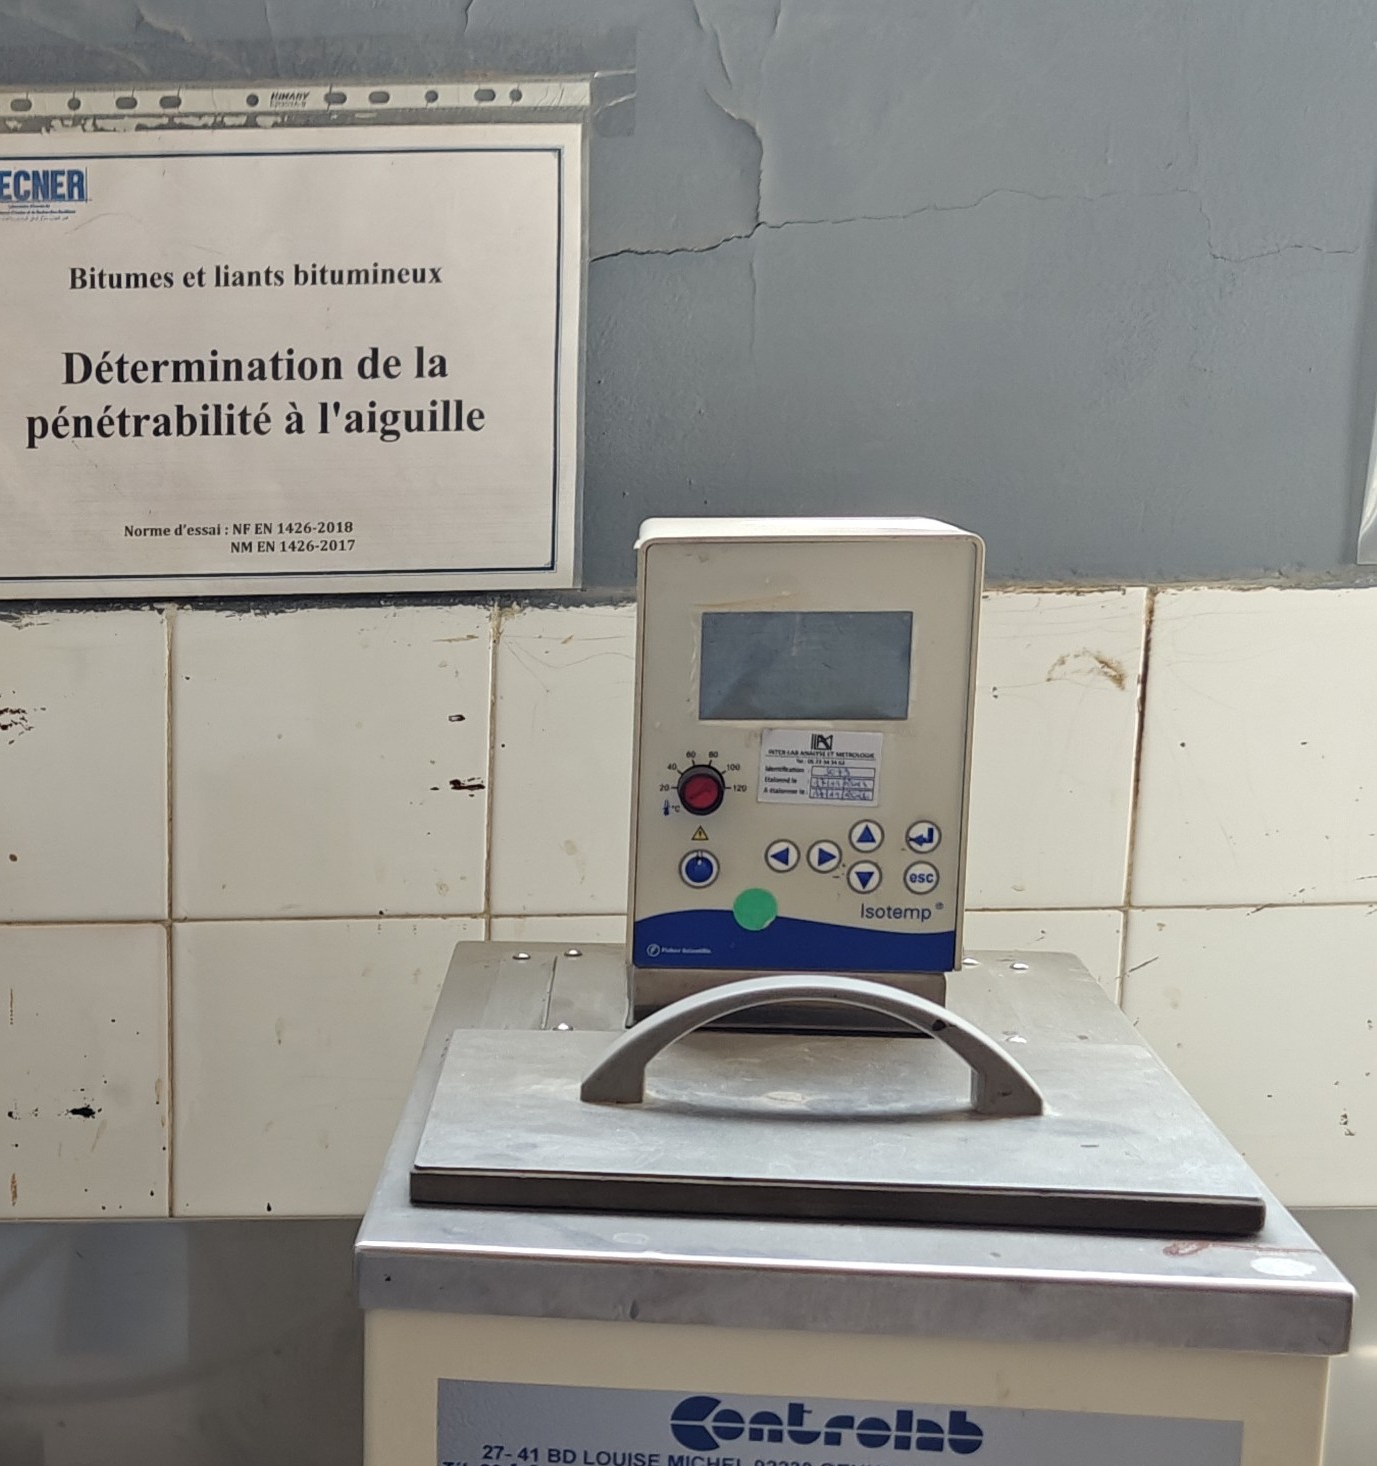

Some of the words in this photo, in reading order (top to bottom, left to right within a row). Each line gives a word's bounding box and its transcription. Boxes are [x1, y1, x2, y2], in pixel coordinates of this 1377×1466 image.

[69, 266, 174, 289] Bitumes
[182, 268, 207, 289] et
[214, 264, 285, 288] liants
[294, 263, 443, 286] bitumineux
[62, 349, 343, 386] Détermination
[357, 348, 401, 381] de
[414, 347, 448, 379] la
[26, 404, 271, 448] pénétrabilité
[285, 402, 305, 434] à
[318, 400, 485, 442] l'aiguille
[124, 524, 170, 538] Norme
[174, 523, 221, 537] d'essai
[232, 523, 251, 535] NF
[255, 523, 273, 535] EN
[278, 521, 354, 534] 1426-2018
[231, 541, 253, 553] NM
[257, 540, 275, 552] EN
[280, 538, 356, 552] 1426-2017
[909, 871, 934, 885] esc
[860, 902, 932, 921] Isotemp
[548, 1449, 577, 1464] BD
